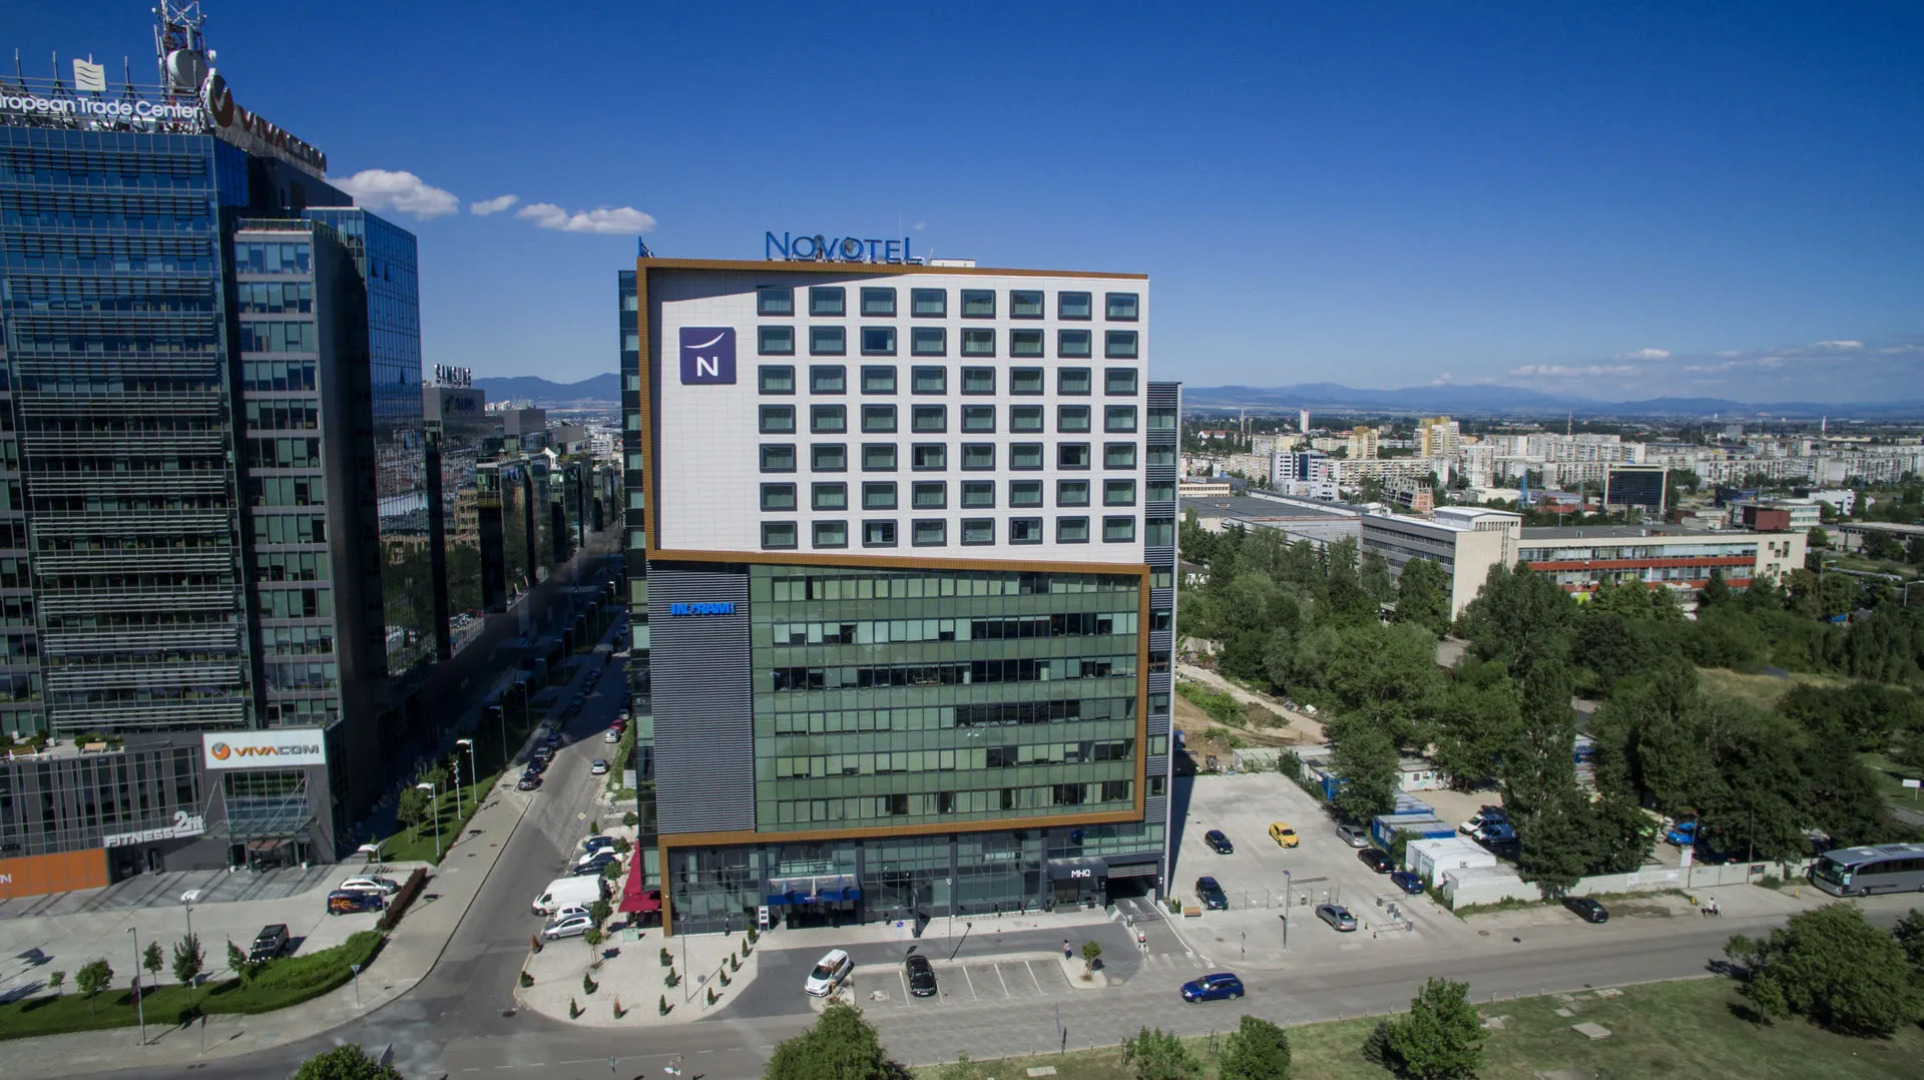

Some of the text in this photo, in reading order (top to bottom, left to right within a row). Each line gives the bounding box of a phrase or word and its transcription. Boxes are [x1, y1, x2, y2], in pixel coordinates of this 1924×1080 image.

[0, 94, 202, 119] ropean Trade Center
[765, 231, 922, 265] NOVOTEL
[697, 356, 719, 377] N
[234, 744, 319, 757] VIVACOM
[103, 828, 173, 848] FITNESS
[1071, 869, 1091, 878] MHQ
